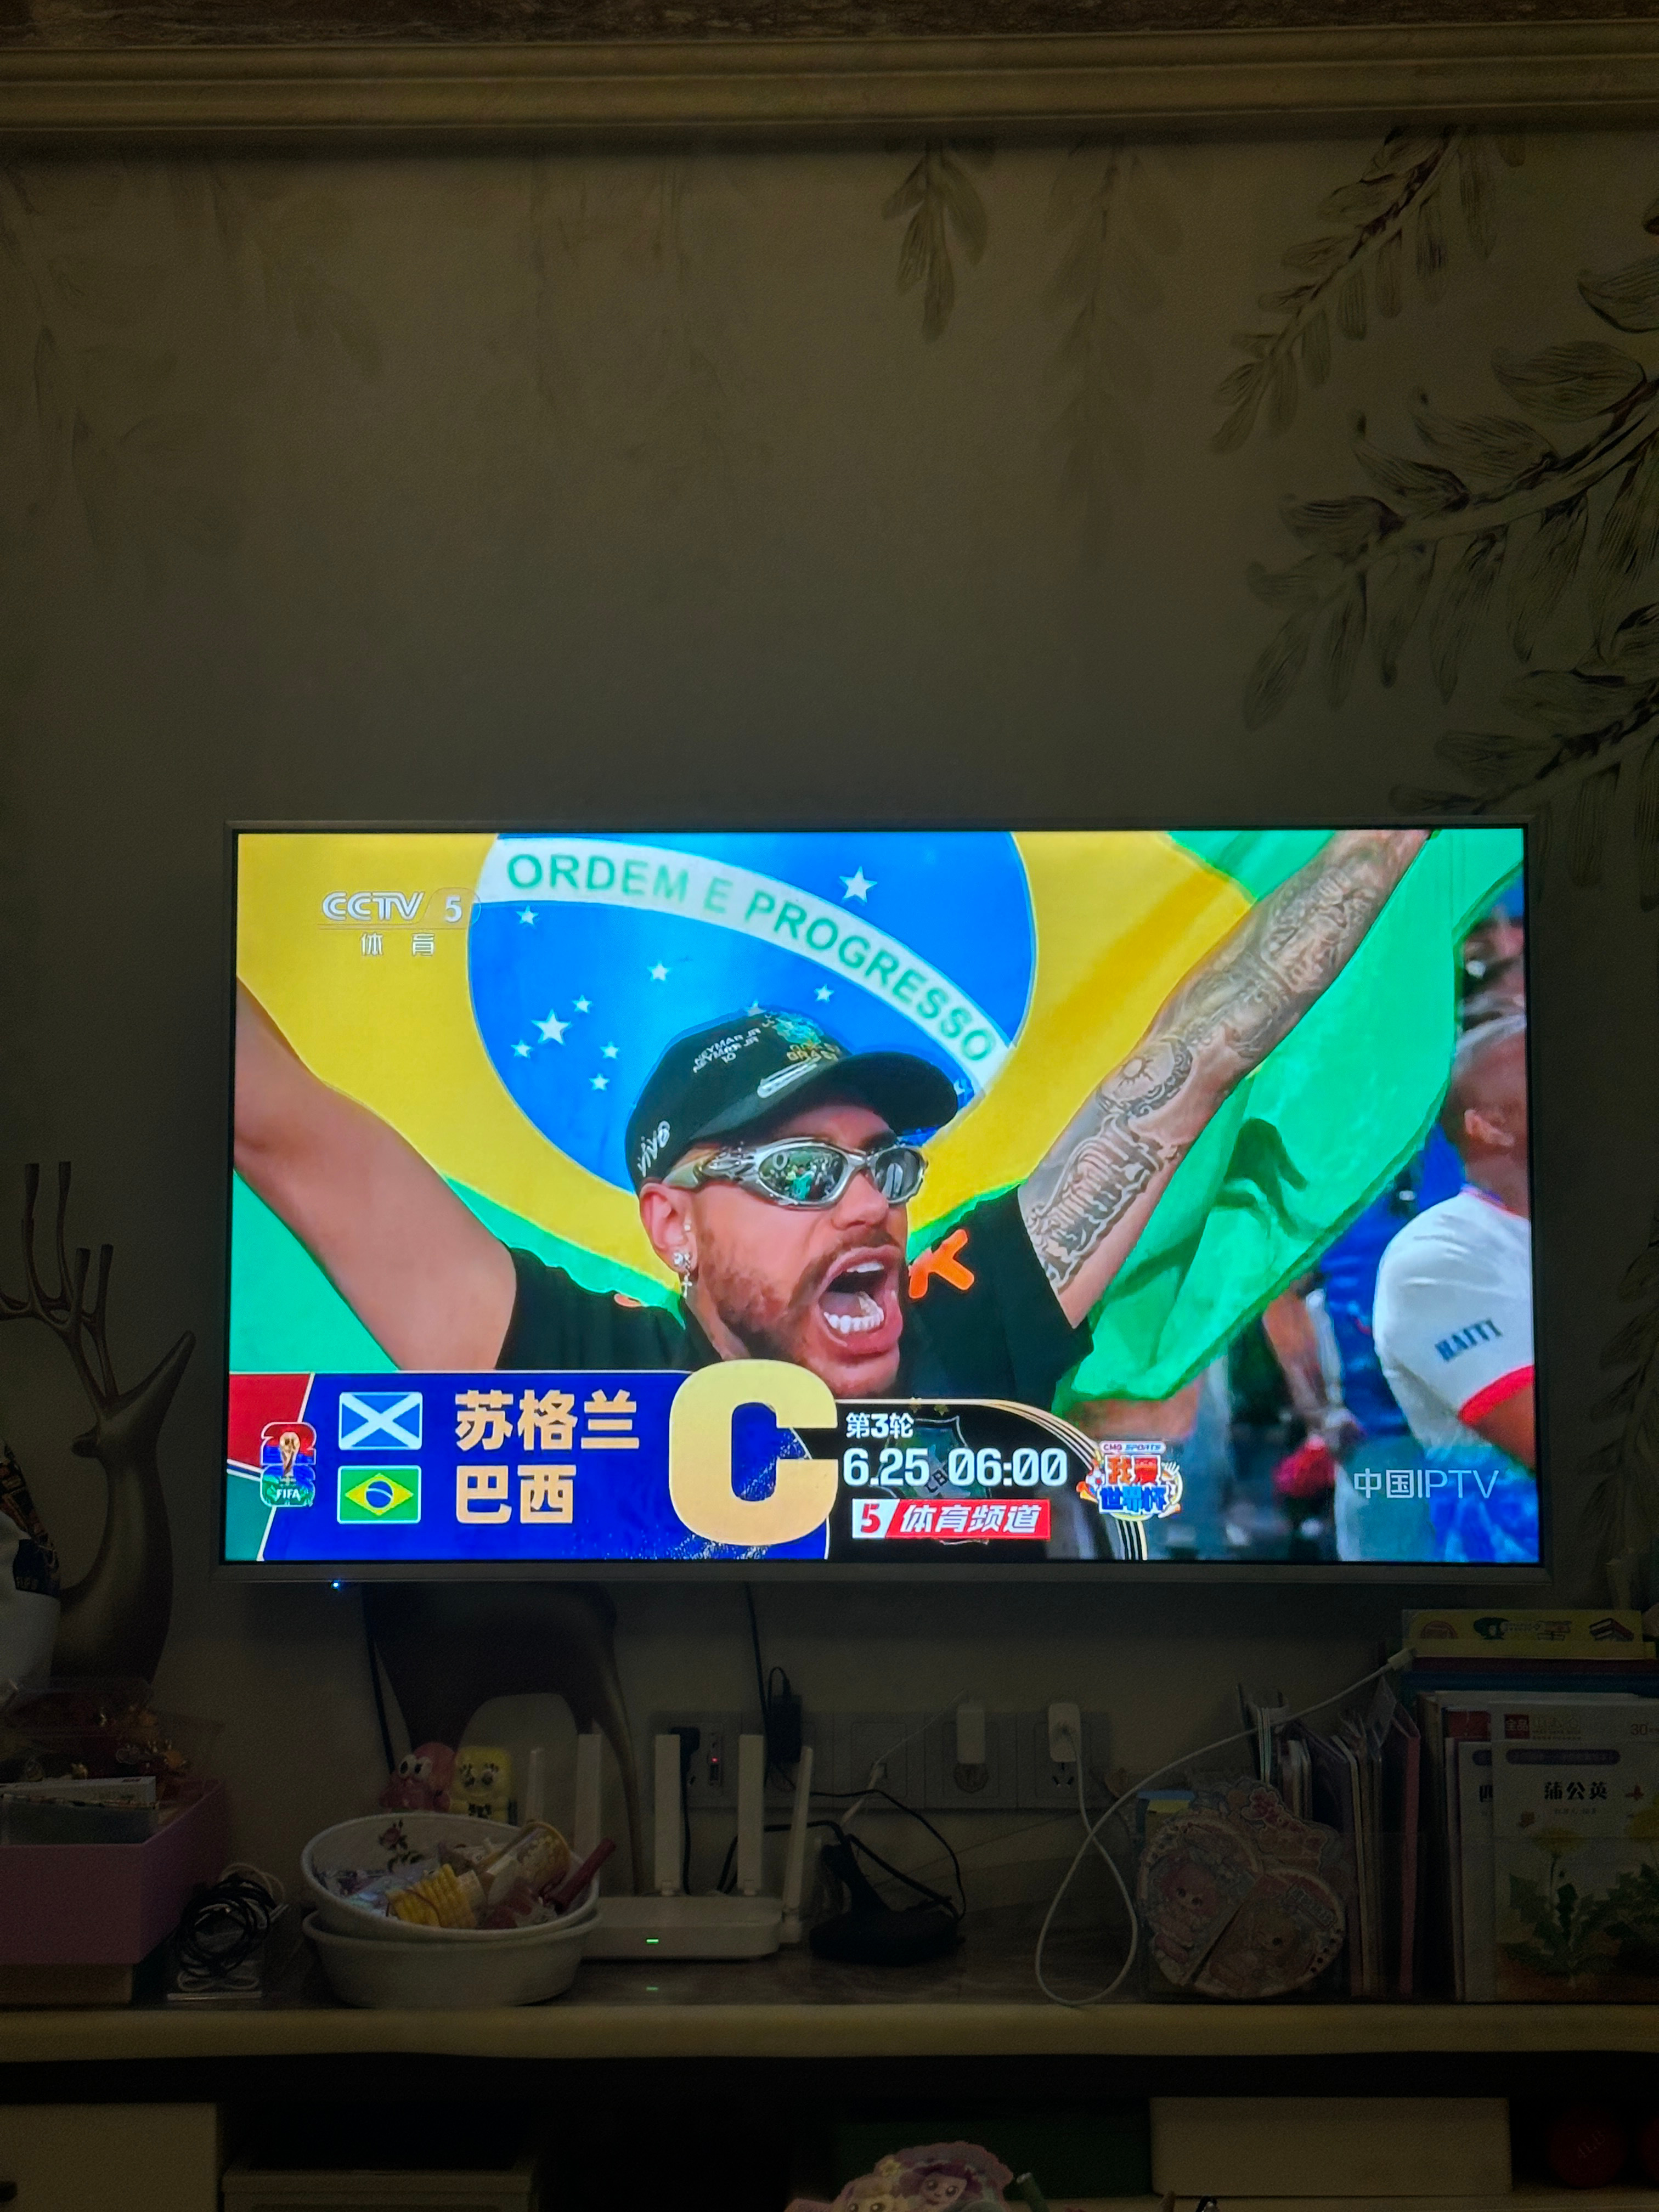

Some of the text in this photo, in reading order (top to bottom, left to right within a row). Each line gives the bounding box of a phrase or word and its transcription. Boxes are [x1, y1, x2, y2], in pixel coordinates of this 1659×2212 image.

[322, 891, 462, 923] CCTV 5
[360, 933, 436, 956] 体育
[506, 853, 996, 1062] ORDEM E PROGRESSO
[1435, 1319, 1503, 1362] HAITI
[455, 1389, 640, 1451] 苏格兰
[845, 1413, 914, 1438] 第3轮
[669, 1359, 839, 1546] C
[843, 1447, 1068, 1487] 6.25 06:00
[275, 1488, 301, 1502] FIFA
[455, 1464, 577, 1525] 巴西
[1100, 1485, 1167, 1513] 世界杯
[1353, 1468, 1499, 1499] 中国IPTV
[900, 1504, 1041, 1533] 体育频道
[1544, 1781, 1608, 1801] 蒲公英
